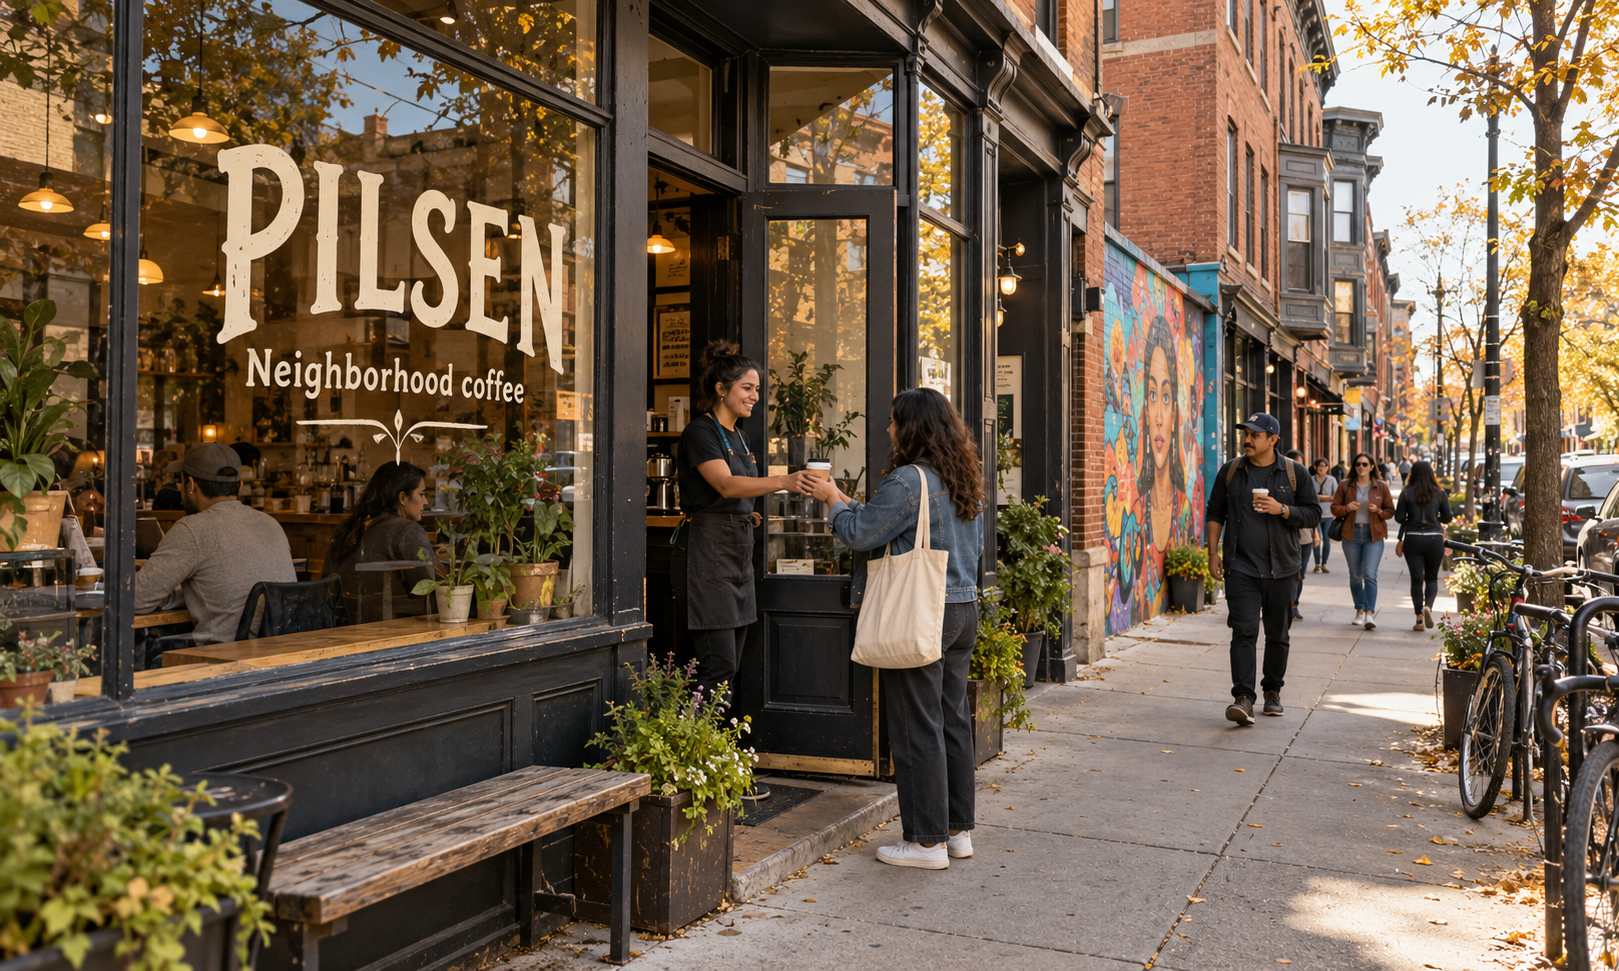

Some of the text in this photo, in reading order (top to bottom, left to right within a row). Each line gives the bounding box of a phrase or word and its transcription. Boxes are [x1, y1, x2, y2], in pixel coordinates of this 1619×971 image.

[217, 144, 566, 375] PILSEN
[246, 348, 524, 404] Neighborhood coffee
